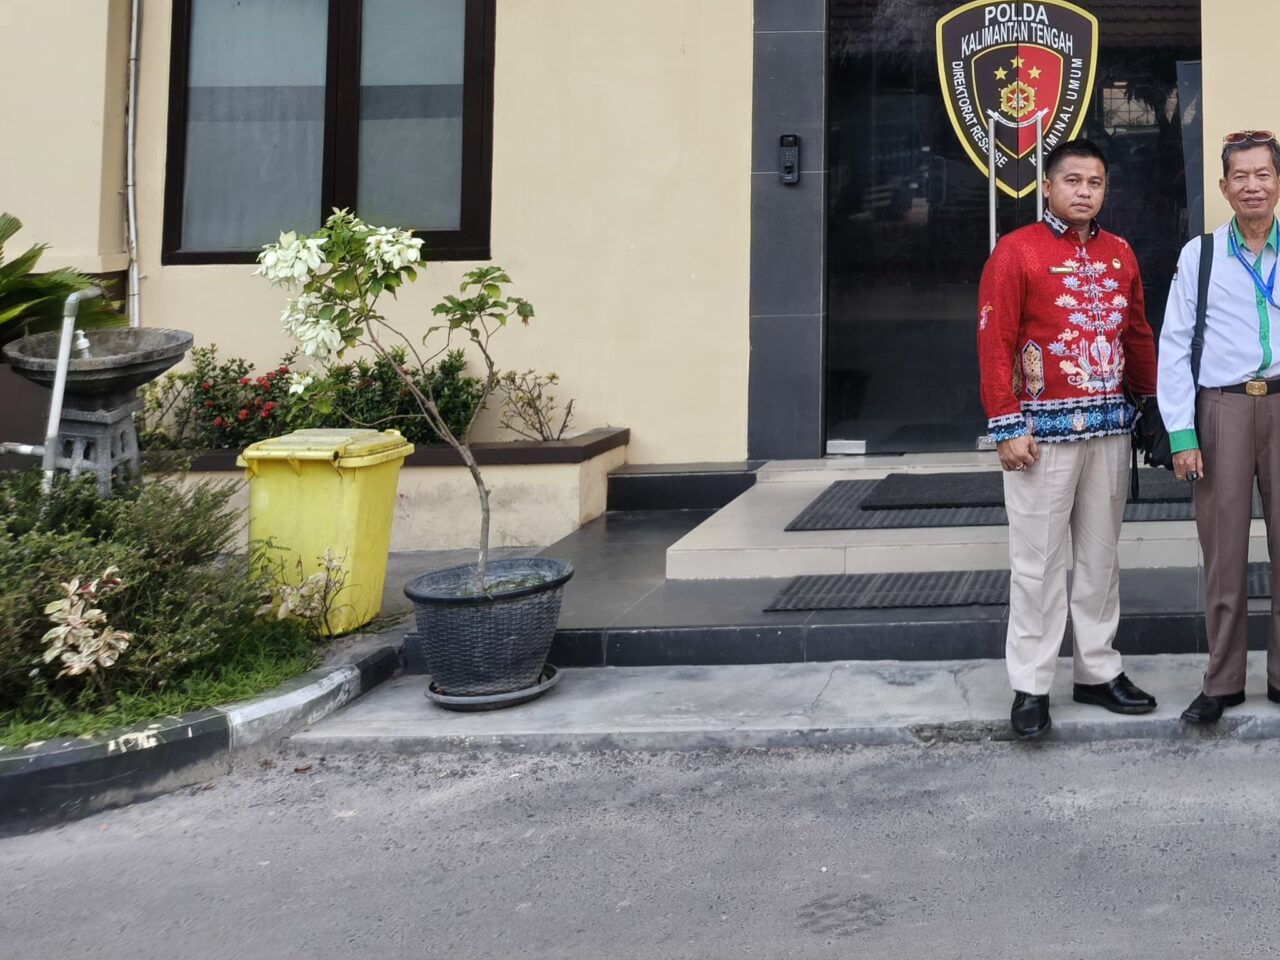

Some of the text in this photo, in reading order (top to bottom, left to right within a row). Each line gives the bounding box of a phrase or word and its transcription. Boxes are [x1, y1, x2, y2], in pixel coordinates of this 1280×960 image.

[961, 22, 1074, 58] KALIMANTAN TENGAH
[984, 2, 1049, 26] POLDA
[952, 61, 1008, 168] DIREKTORAT RESESE
[1028, 58, 1083, 166] KIMINAL UMUM
